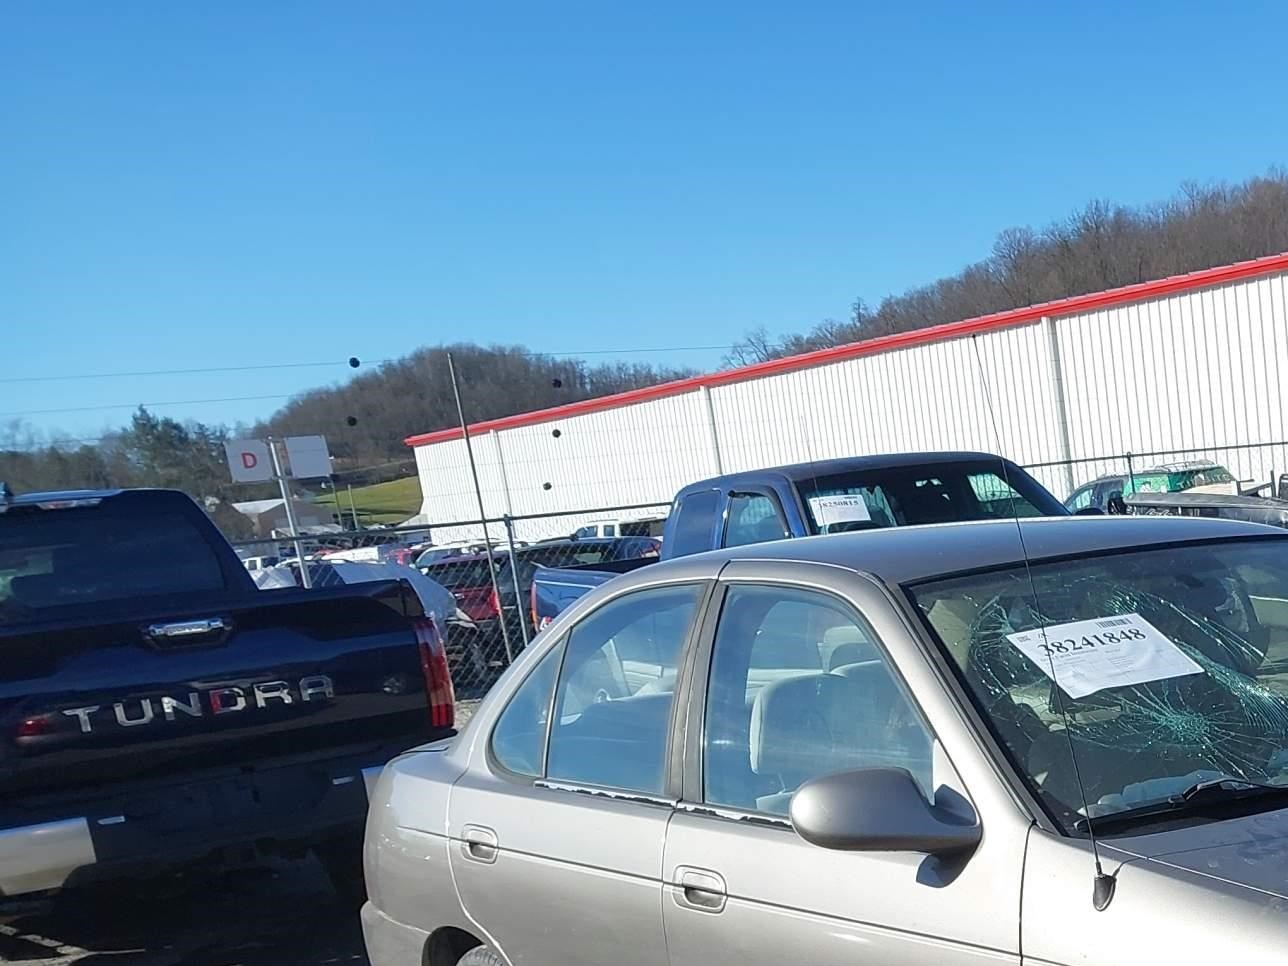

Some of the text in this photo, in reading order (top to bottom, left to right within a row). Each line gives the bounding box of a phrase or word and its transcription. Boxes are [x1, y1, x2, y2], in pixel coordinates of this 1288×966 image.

[241, 452, 257, 469] D
[1037, 628, 1147, 657] 38241848
[62, 675, 334, 733] TUNDRA
